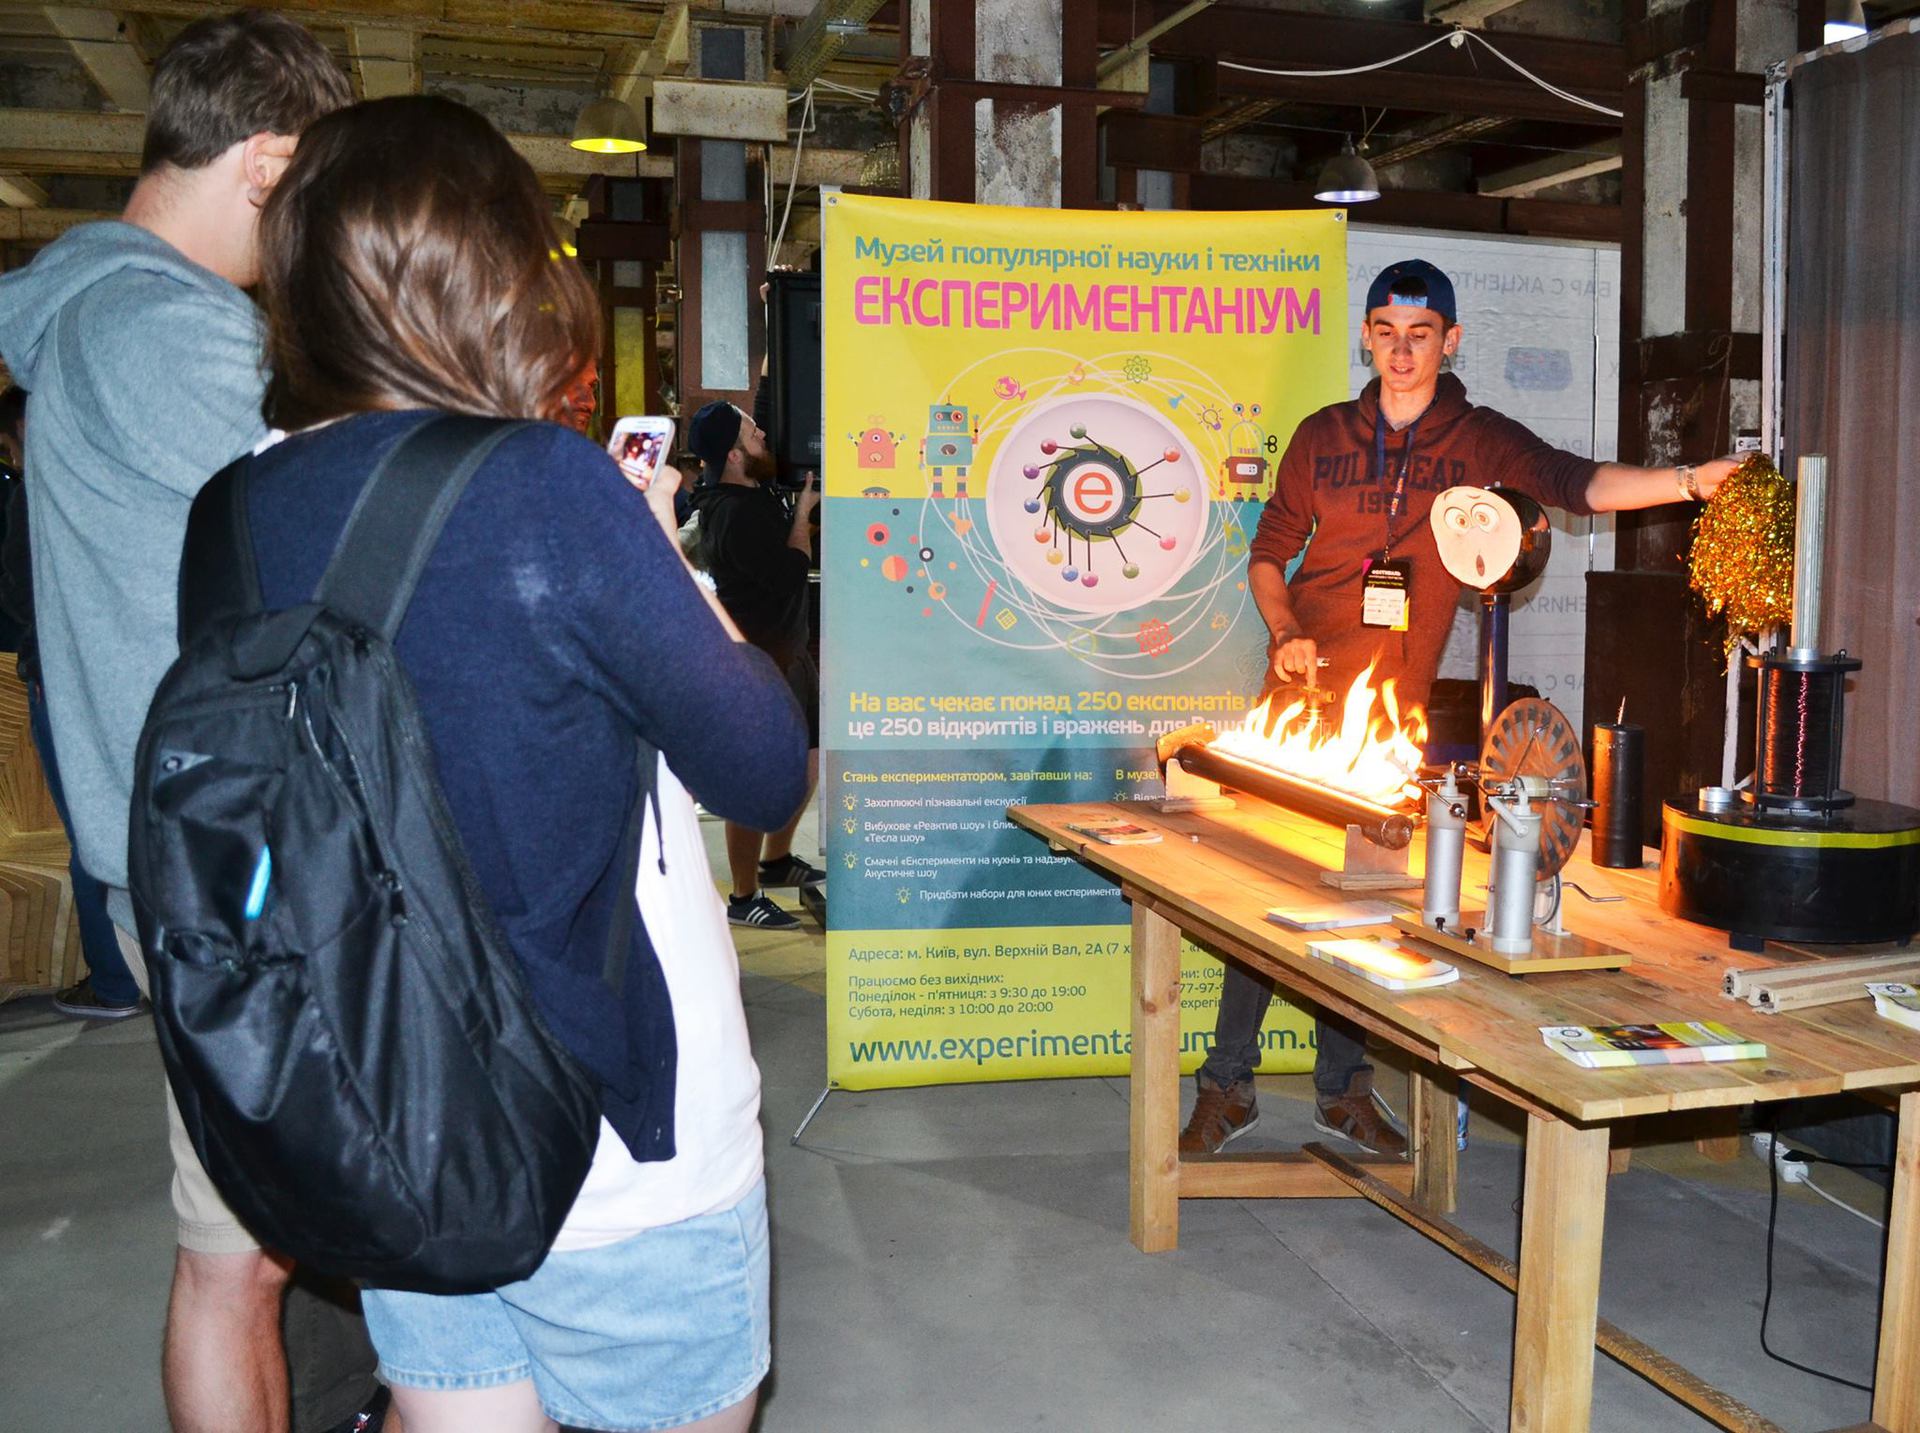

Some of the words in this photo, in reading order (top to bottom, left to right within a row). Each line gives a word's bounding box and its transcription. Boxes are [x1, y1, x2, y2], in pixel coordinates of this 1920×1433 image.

[855, 236, 943, 266] Музей
[951, 245, 1109, 273] популярної
[1118, 253, 1199, 276] науки
[1207, 247, 1213, 271] і
[1220, 248, 1320, 272] техніки
[854, 276, 1321, 336] ЕКСПЕРИМЕНТАНІУМ
[1313, 451, 1466, 492] PULLEAR
[849, 692, 881, 713] На
[886, 696, 927, 713] вас
[930, 695, 996, 713] чекає
[1000, 695, 1072, 715] понад
[1077, 691, 1123, 712] 250
[1126, 691, 1246, 712] експонатів
[848, 720, 876, 740] це
[880, 717, 923, 736] 250
[927, 715, 1037, 740] відкриттів
[1042, 715, 1048, 736] і
[1052, 719, 1145, 740] вражень
[1149, 718, 1187, 738] для
[843, 771, 878, 783] Стань
[881, 772, 1007, 784] експериментатором,
[1010, 769, 1071, 782] завітавши
[1075, 770, 1093, 781] на:
[1116, 769, 1124, 781] В
[864, 797, 923, 808] Захоплюючі
[925, 797, 982, 807] пізнавальні
[984, 795, 1027, 808] екскурсії
[864, 821, 911, 832] Вибухове
[913, 821, 958, 832] «Реактив
[960, 822, 985, 832] шоу»
[865, 833, 898, 843] «Тесла
[901, 835, 926, 844] шоу»
[864, 856, 899, 866] Смачні
[902, 856, 976, 867] «Експерименти
[978, 857, 990, 865] на
[992, 855, 1021, 867] кухні»
[1022, 856, 1033, 864] та
[1035, 856, 1076, 867] надзвук
[864, 869, 915, 880] Акустичне
[917, 870, 938, 880] шоу
[920, 890, 967, 901] Придбати
[970, 890, 1005, 900] набори
[1007, 889, 1025, 899] для
[1027, 888, 1052, 898] юних
[1054, 887, 1122, 898] експеримента
[848, 947, 903, 963] Адреса:
[907, 950, 921, 960] м.
[926, 946, 959, 960] Київ,
[963, 948, 990, 960] вул.
[995, 944, 1048, 961] Верхній
[1052, 943, 1081, 957] Вал,
[1106, 942, 1119, 956] (7
[848, 975, 916, 989] Працюємо
[920, 973, 941, 986] без
[944, 972, 1004, 987] вихідних:
[848, 988, 916, 1004] Понеділок
[927, 988, 987, 1002] п'ятниця:
[1000, 987, 1028, 999] 9:30
[1031, 987, 1047, 1000] до
[1052, 985, 1086, 997] 19:00
[848, 1006, 896, 1020] Субота,
[899, 1004, 946, 1018] неділя:
[959, 1002, 995, 1015] 10:00
[997, 1003, 1014, 1016] до
[1017, 1001, 1054, 1013] 20:00
